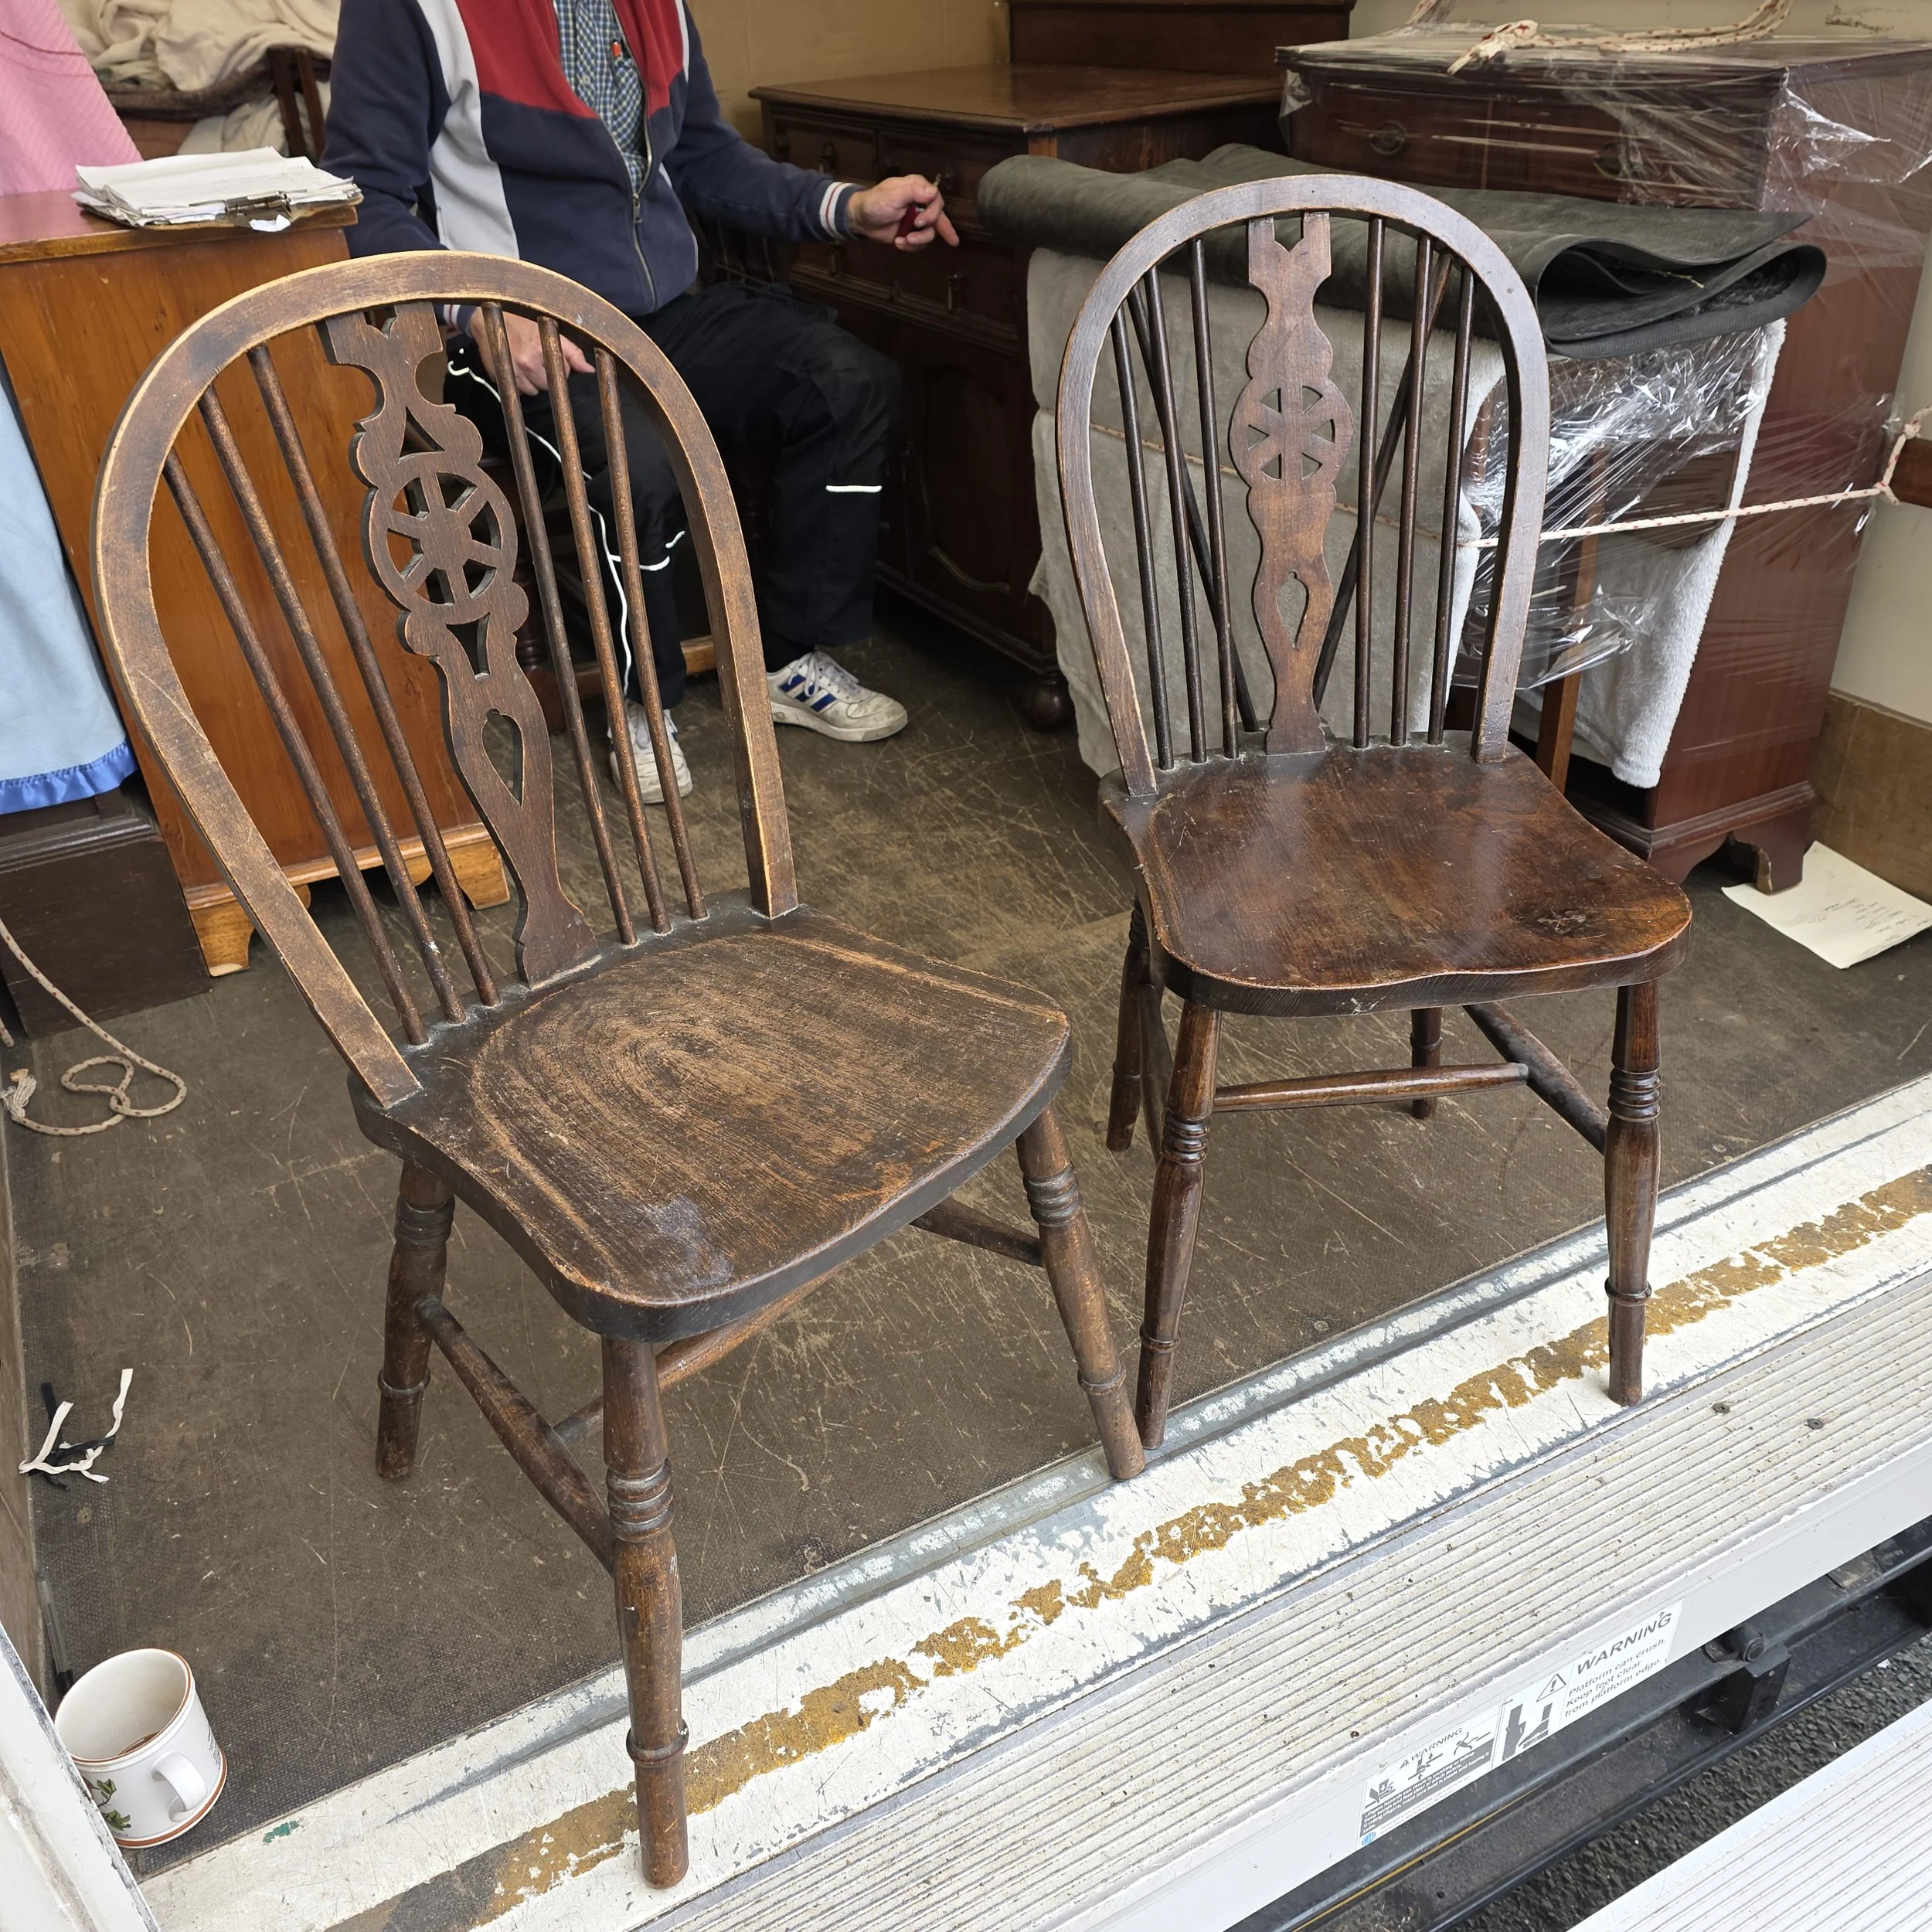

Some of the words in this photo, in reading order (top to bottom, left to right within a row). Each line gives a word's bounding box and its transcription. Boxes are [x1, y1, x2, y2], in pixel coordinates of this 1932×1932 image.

[1577, 1613, 1672, 1675] WARNING
[1565, 1700, 1588, 1717] from
[1590, 1675, 1633, 1704] platform
[1635, 1659, 1662, 1676] edge.
[1566, 1689, 1593, 1707] Keep
[1595, 1676, 1614, 1691] feet
[1617, 1661, 1641, 1678] clear
[1569, 1667, 1612, 1697] Platform
[1614, 1657, 1633, 1670] can
[1410, 1728, 1463, 1761] WARNING
